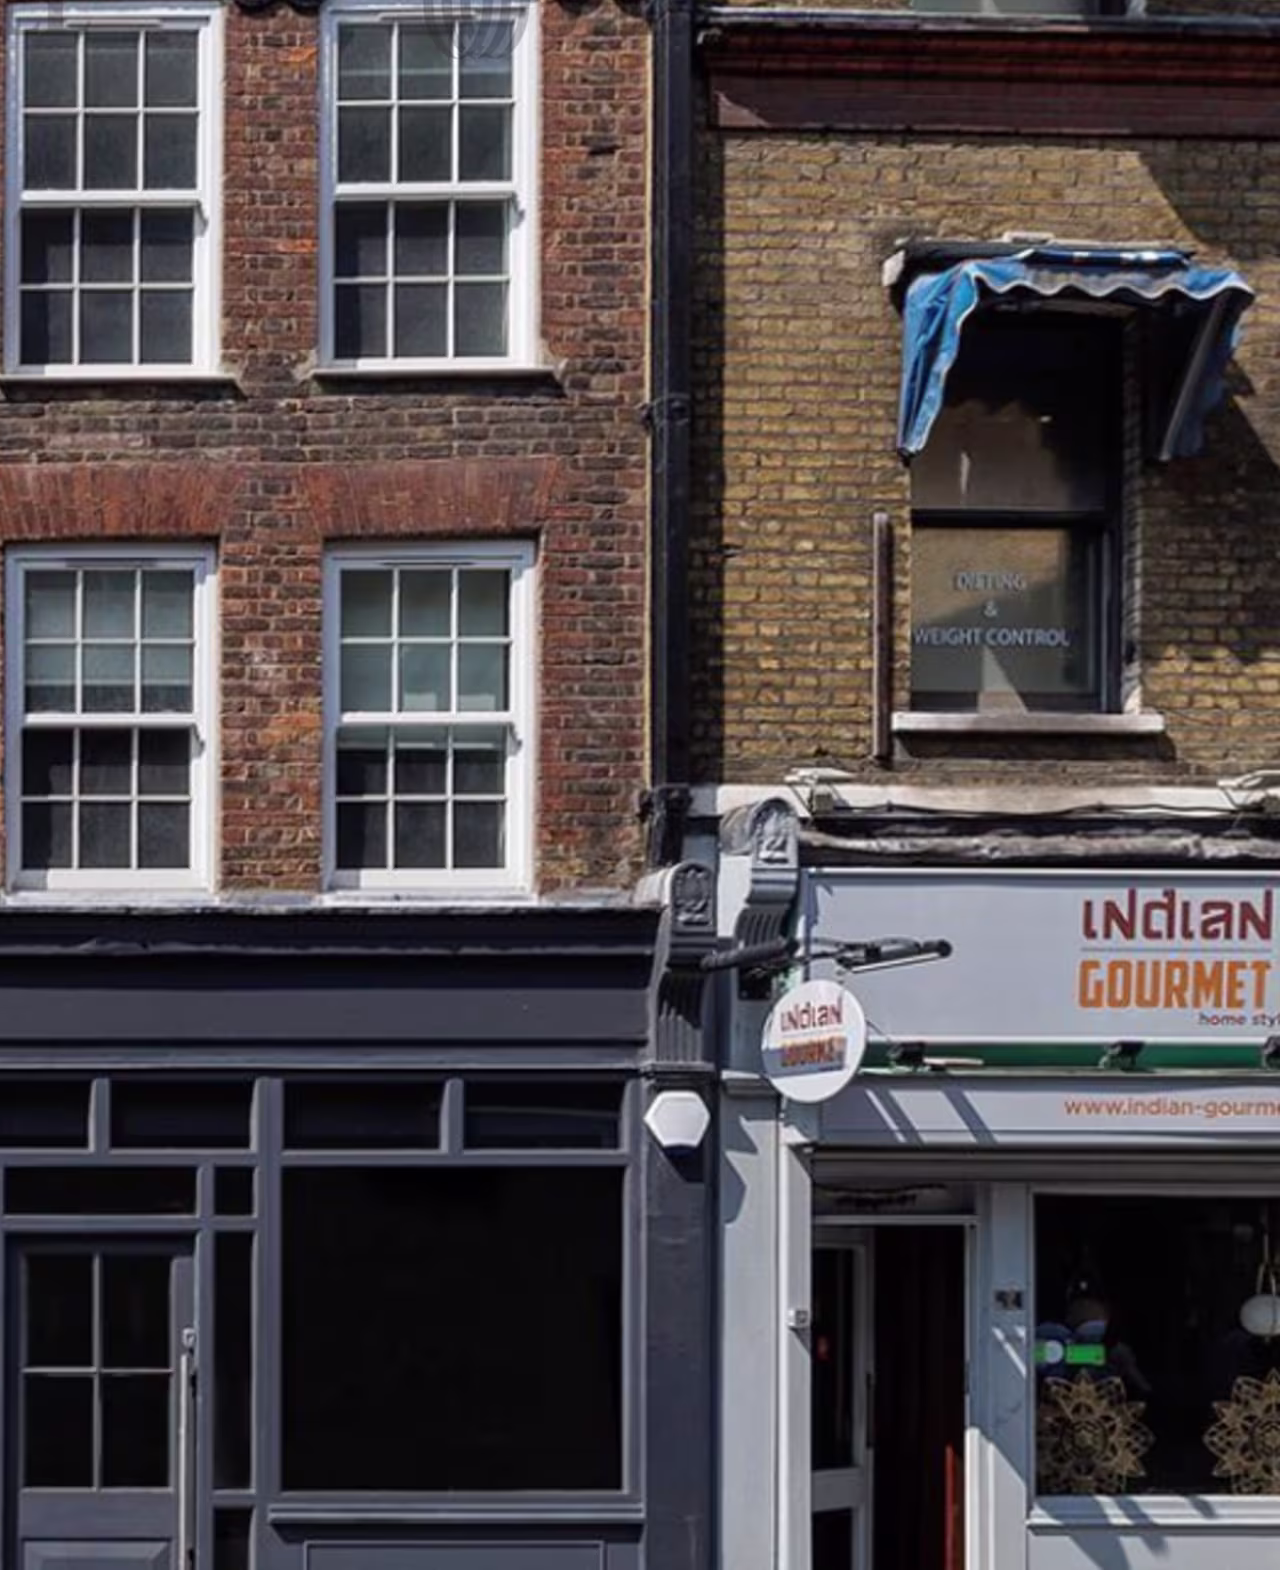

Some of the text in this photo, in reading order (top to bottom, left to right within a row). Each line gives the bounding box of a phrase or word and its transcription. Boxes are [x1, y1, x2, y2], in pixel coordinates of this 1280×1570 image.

[983, 601, 998, 618] &
[915, 628, 1070, 647] WEIGHT CONTROL
[1079, 960, 1271, 1009] GOURMET
[1197, 1012, 1246, 1026] home
[1064, 1098, 1280, 1118] www.indian-gourm
